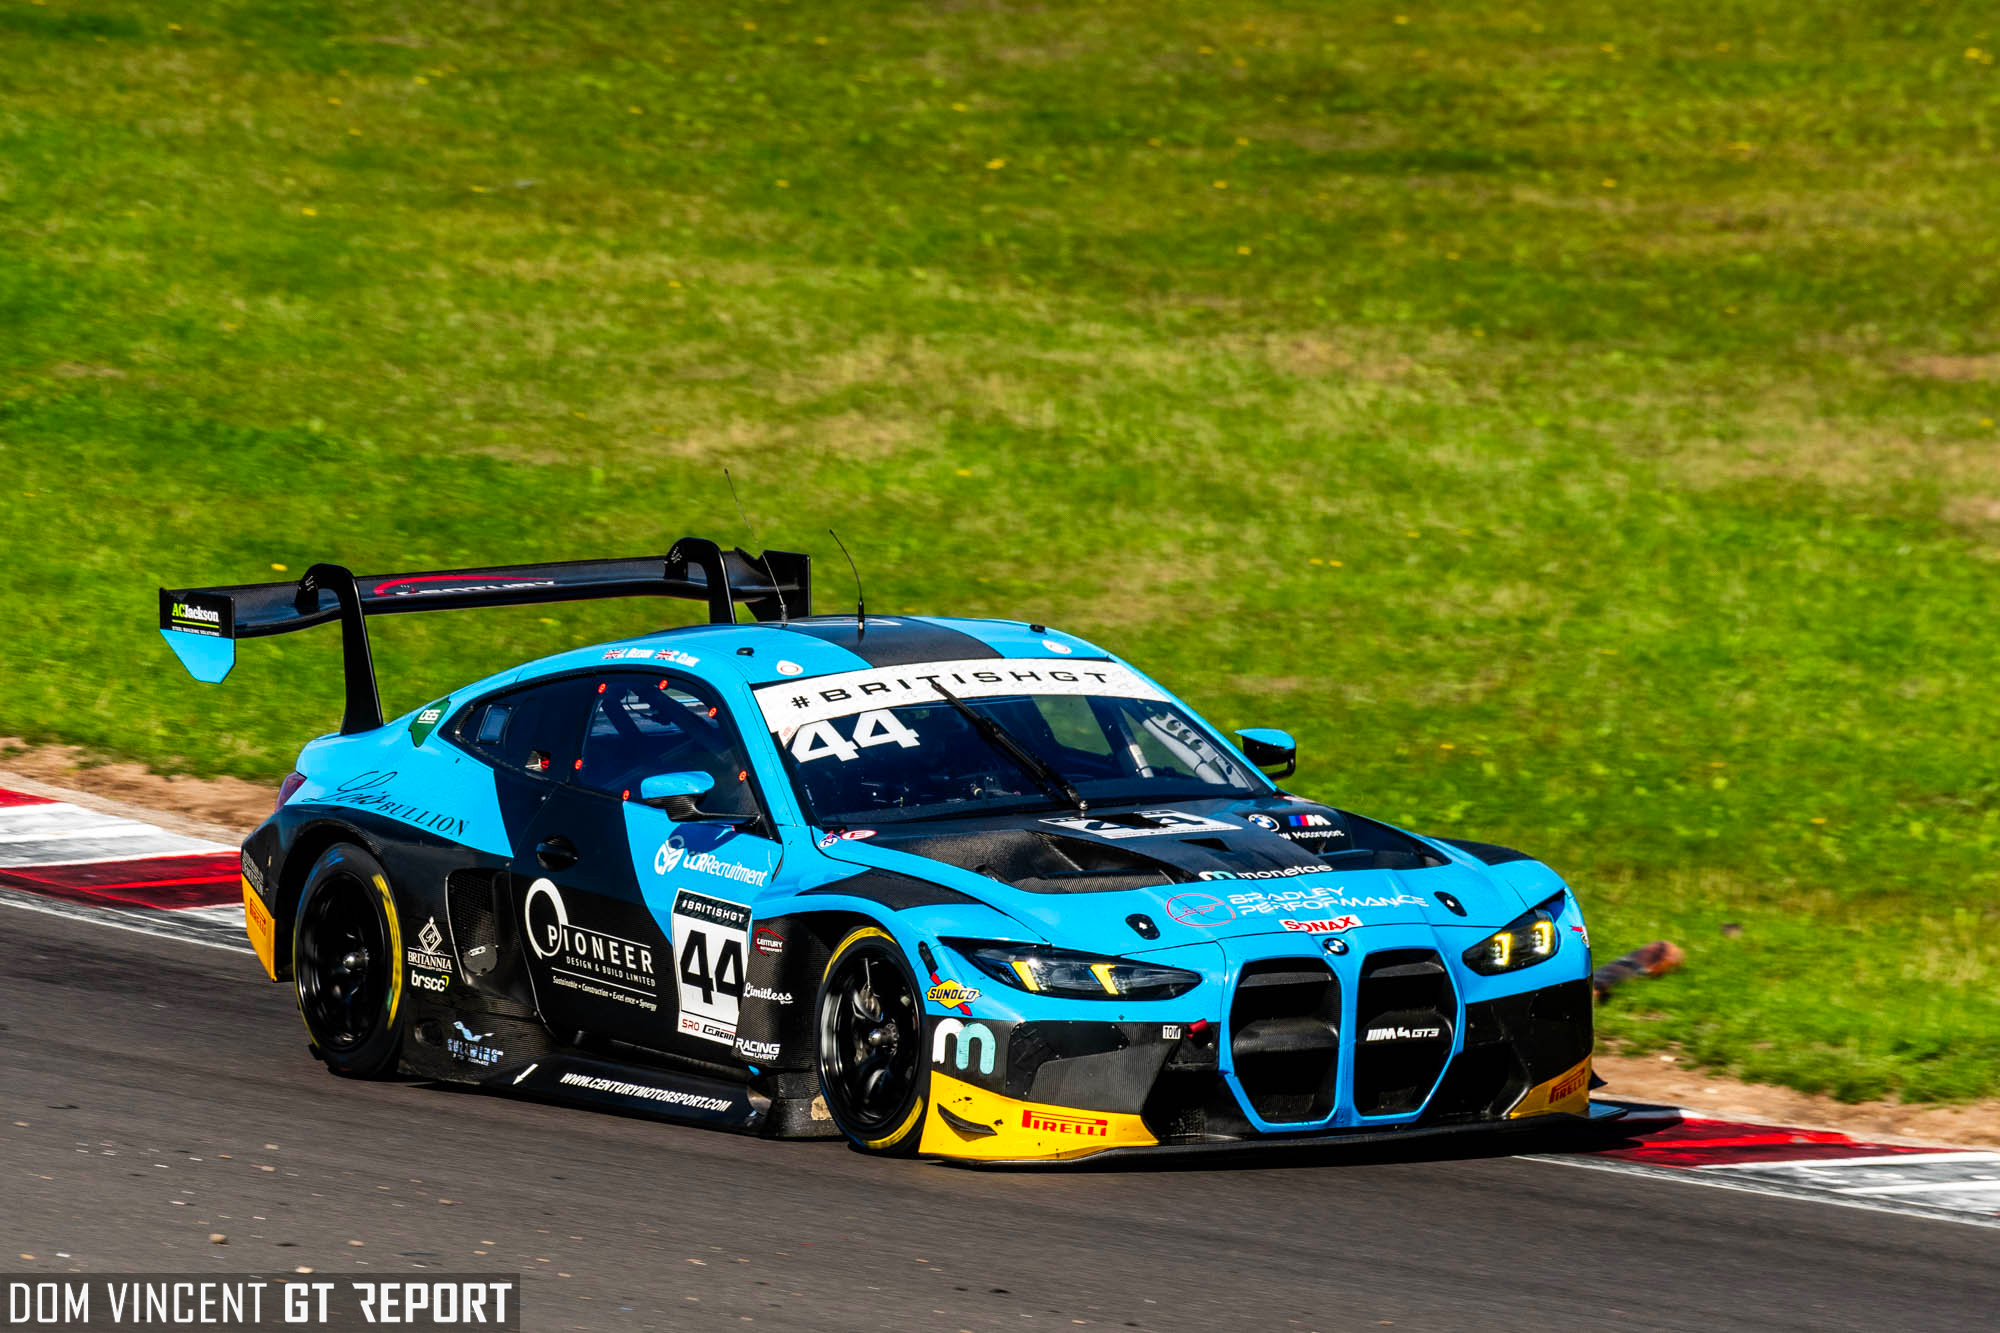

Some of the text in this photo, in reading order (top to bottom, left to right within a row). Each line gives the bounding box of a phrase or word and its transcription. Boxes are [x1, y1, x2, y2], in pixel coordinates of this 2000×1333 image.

[172, 603, 219, 622] ACJackson
[791, 670, 1107, 709] #BRITISHGT
[791, 709, 920, 763] 44
[376, 801, 469, 836] BULLION
[1237, 864, 1334, 880] monetae
[1227, 886, 1345, 905] BRADLEY
[682, 900, 745, 923] #BRITISHGT
[1235, 895, 1429, 916] PERFORMANCE
[1284, 916, 1357, 933] SONAX
[547, 924, 655, 974] PIONEER
[408, 951, 452, 970] BRITANNIA
[680, 929, 746, 1006] 44
[411, 970, 446, 992] brscc
[566, 956, 656, 987] DESIGN & BUILD LIMITED
[581, 983, 609, 998] Construction
[743, 982, 793, 1001] Limitless
[929, 987, 977, 1001] SUNOCO
[682, 1018, 700, 1032] SRO
[1164, 1026, 1180, 1039] TOW
[1411, 1027, 1440, 1038] GT3
[735, 1037, 780, 1056] RACING
[755, 1052, 778, 1061] LIVERY
[560, 1072, 732, 1113] WWW.CENTURYMOTORSPORT.COM
[1550, 1067, 1586, 1104] PIRELLI
[1022, 1109, 1108, 1137] PIRELLI
